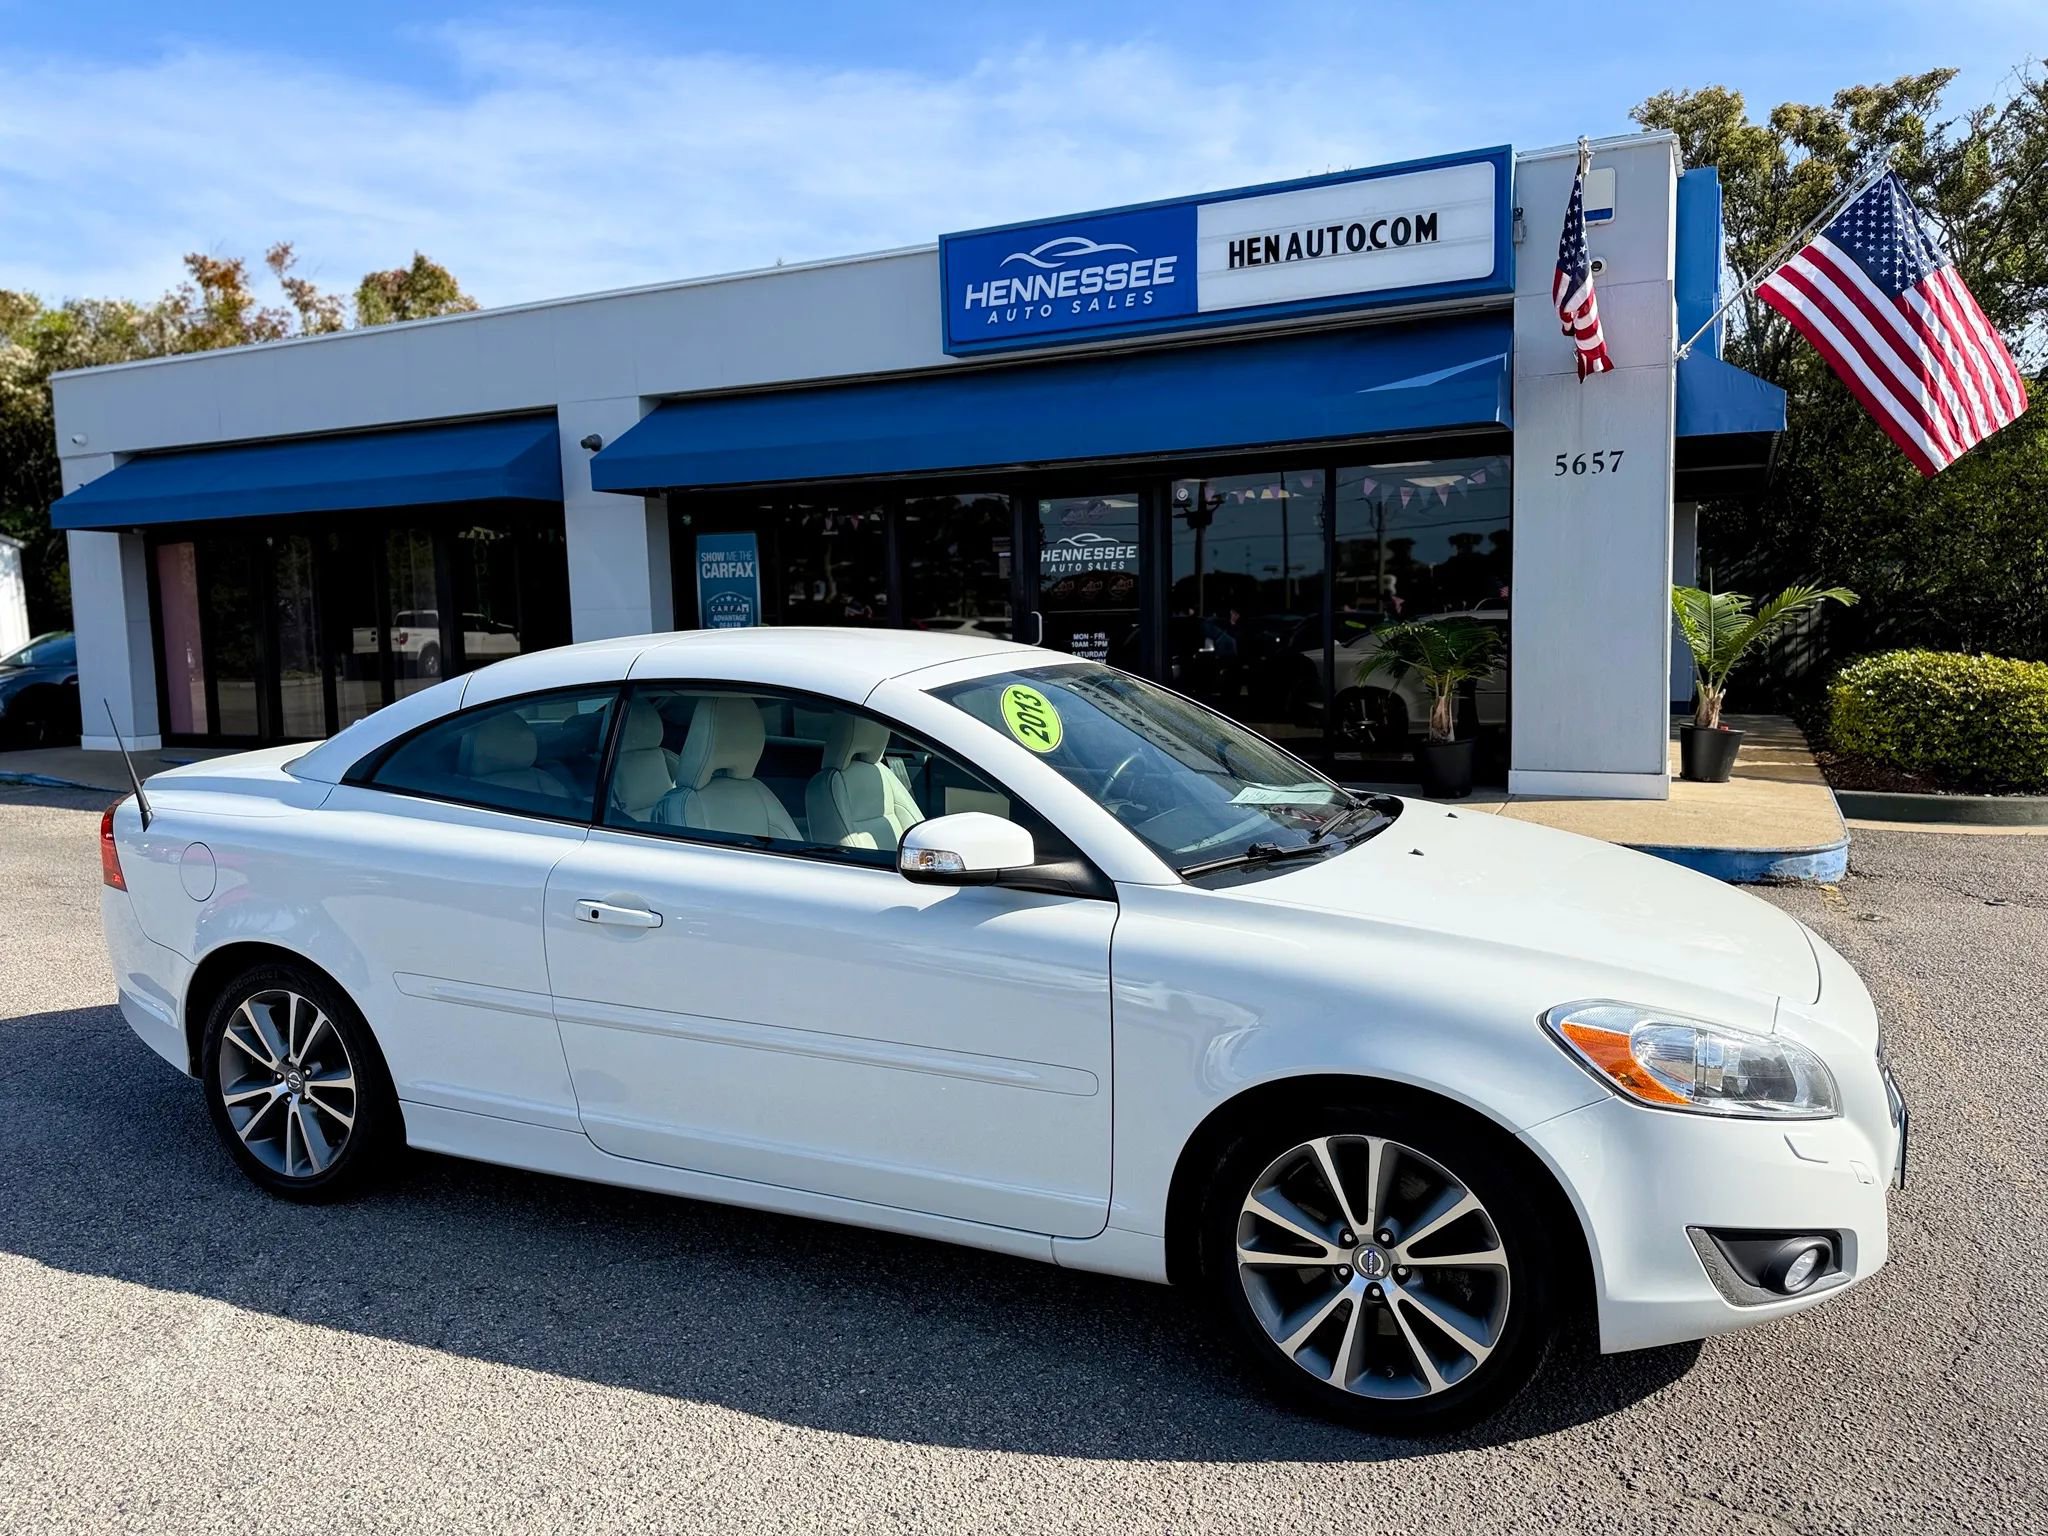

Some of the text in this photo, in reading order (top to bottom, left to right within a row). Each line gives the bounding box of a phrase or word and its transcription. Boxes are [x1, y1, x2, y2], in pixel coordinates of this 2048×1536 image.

[1229, 212, 1438, 269] HENAUTO.COM
[964, 255, 1178, 310] HENNESSEE
[987, 290, 1154, 325] AUTO SALES
[1554, 449, 1625, 477] 5657
[701, 550, 754, 562] SHOW ME THE
[1040, 545, 1137, 563] HENNESSEE
[702, 561, 755, 579] CARFAX
[1050, 560, 1126, 573] AUTO SALES
[713, 613, 748, 622] ADVANTAGE
[1094, 632, 1106, 640] FRI
[1012, 690, 1051, 745] 2013
